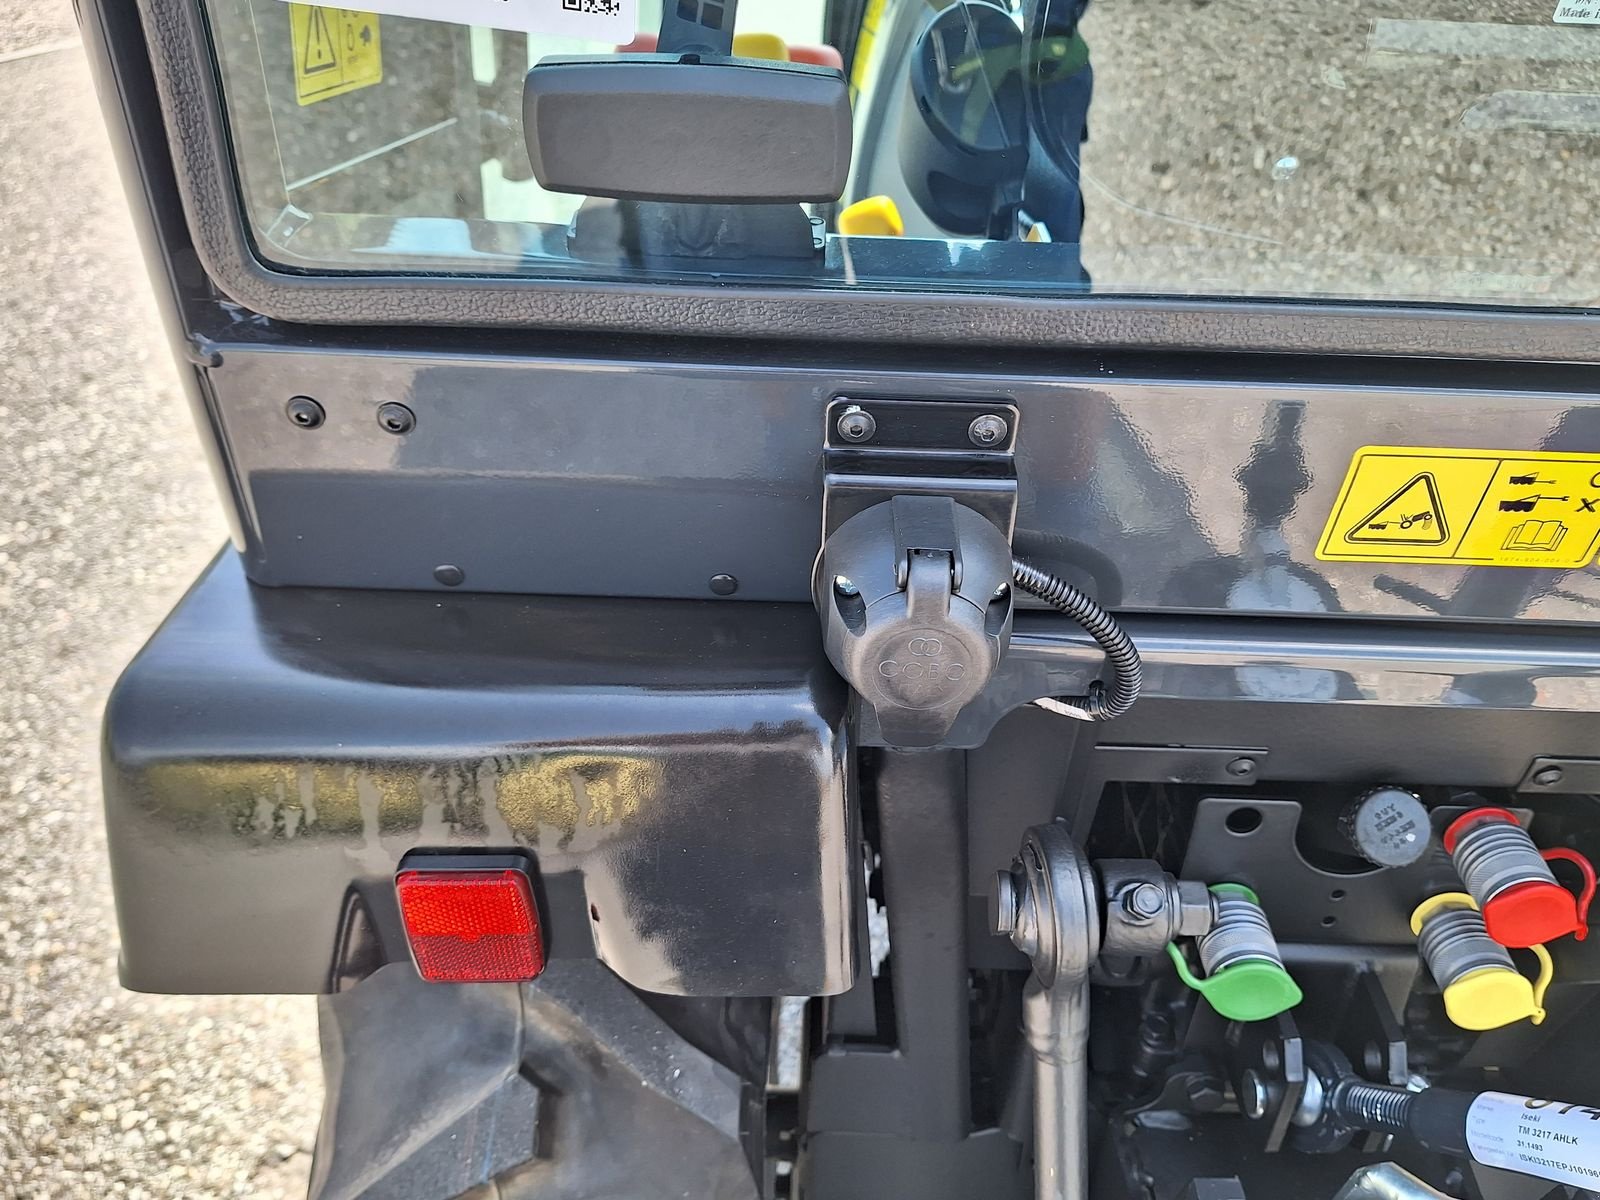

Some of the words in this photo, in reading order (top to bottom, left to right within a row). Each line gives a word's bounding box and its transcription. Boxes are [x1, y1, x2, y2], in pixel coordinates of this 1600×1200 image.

[1559, 7, 1591, 18] Made
[878, 659, 965, 681] COBO
[1520, 1112, 1541, 1123] Iseki
[1518, 1125, 1530, 1135] TM
[1531, 1128, 1552, 1139] 3217
[1552, 1132, 1579, 1145] AHLK
[1516, 1139, 1543, 1152] 31.1493
